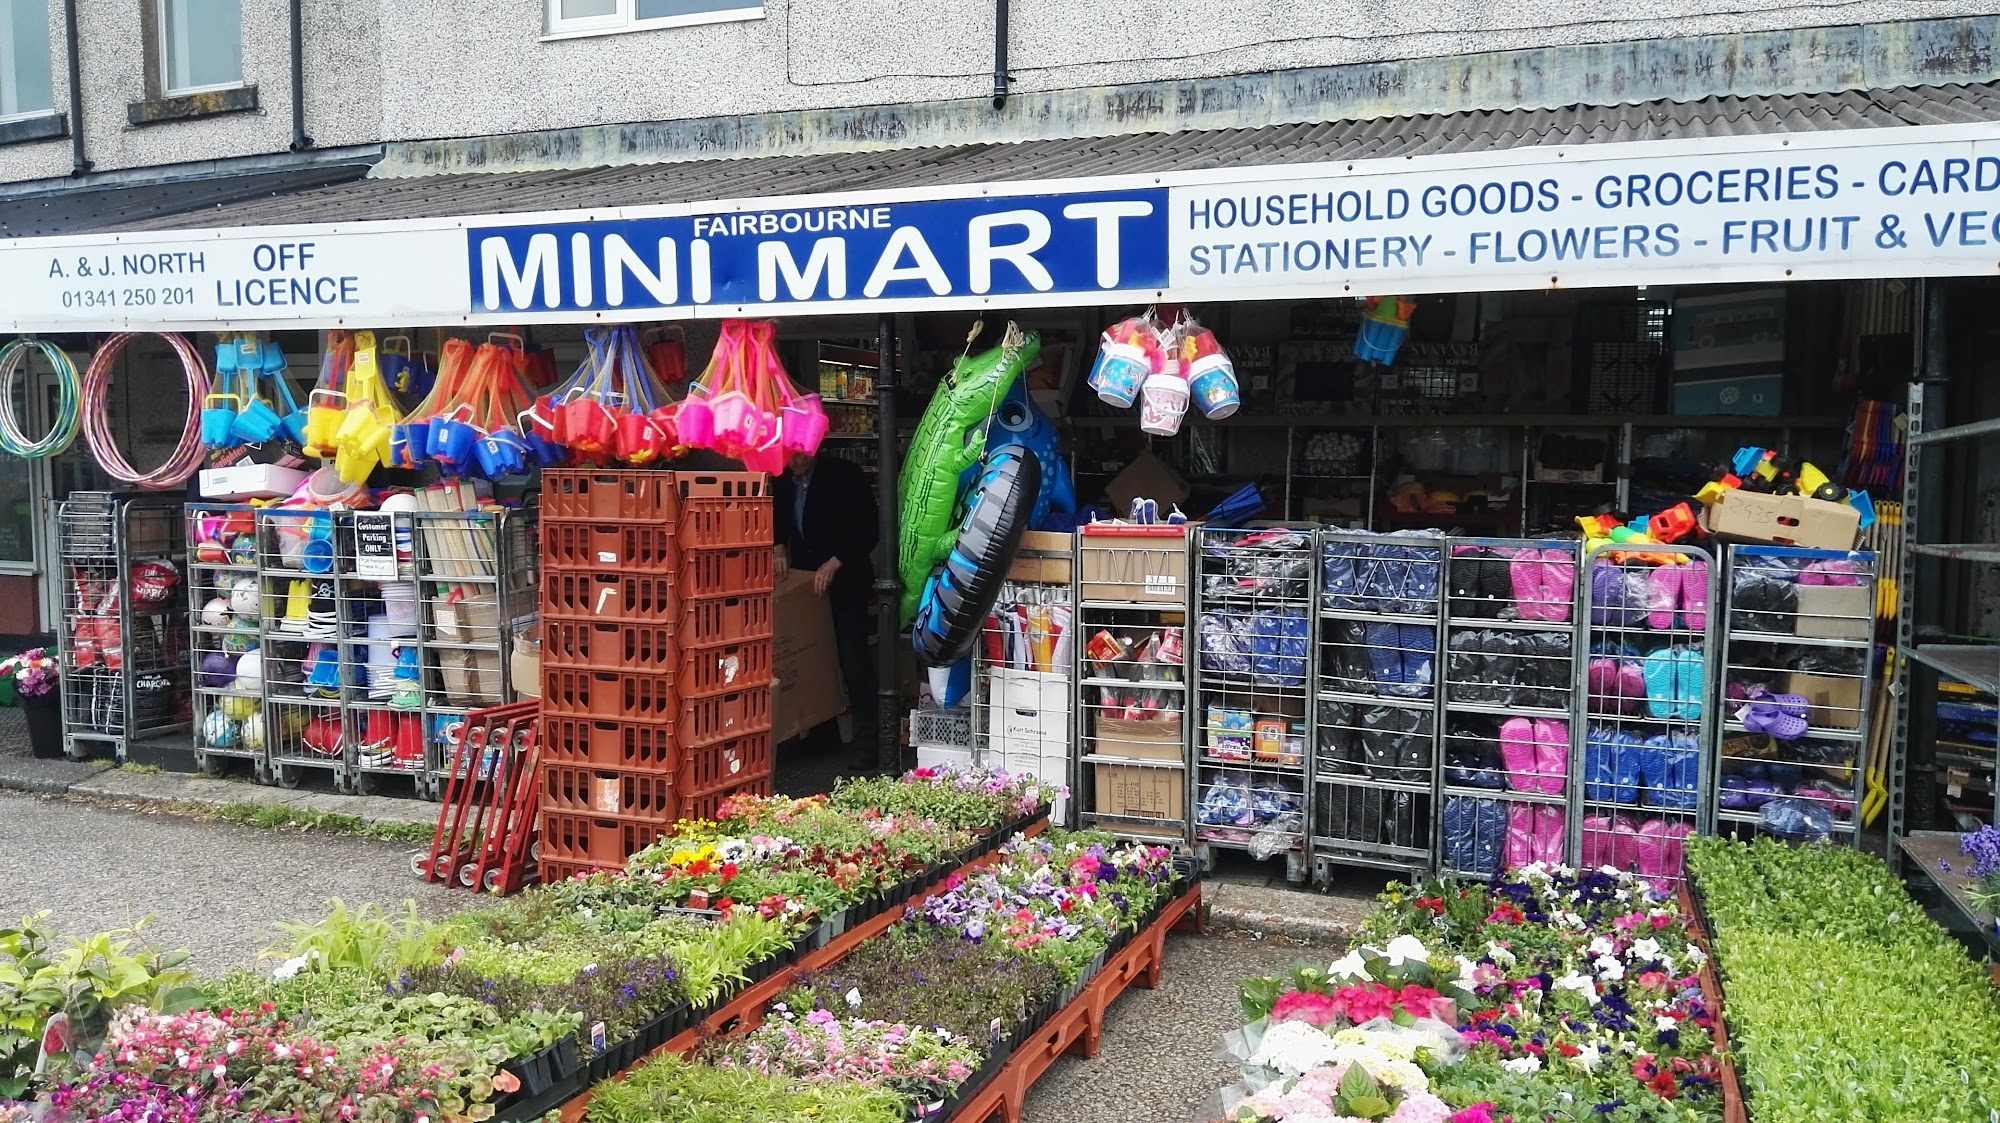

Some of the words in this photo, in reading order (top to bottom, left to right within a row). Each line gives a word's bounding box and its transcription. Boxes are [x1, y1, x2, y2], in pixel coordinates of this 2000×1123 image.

[1190, 188, 1409, 230] HOUSEHOLD
[1422, 179, 1559, 218] GOODS
[1595, 163, 1838, 208] GROCERIES
[694, 207, 891, 237] FAIRBOURNE
[253, 243, 315, 272] OFF
[481, 232, 711, 310] MINI
[757, 200, 1153, 302] MART
[1190, 234, 1432, 276] STATIONERY
[1469, 227, 1680, 264] FLOWERS
[1722, 215, 1860, 255] FRUIT
[1874, 214, 1907, 249] &
[49, 258, 69, 278] A.
[77, 257, 92, 277] &
[99, 256, 115, 276] J.
[123, 252, 205, 275] NORTH
[62, 291, 116, 308] 01341
[123, 288, 156, 306] 250
[162, 287, 194, 305] 201
[216, 276, 359, 307] LICENCE
[358, 522, 388, 531] Customer
[362, 533, 387, 543] Parking
[365, 544, 382, 552] ONLY
